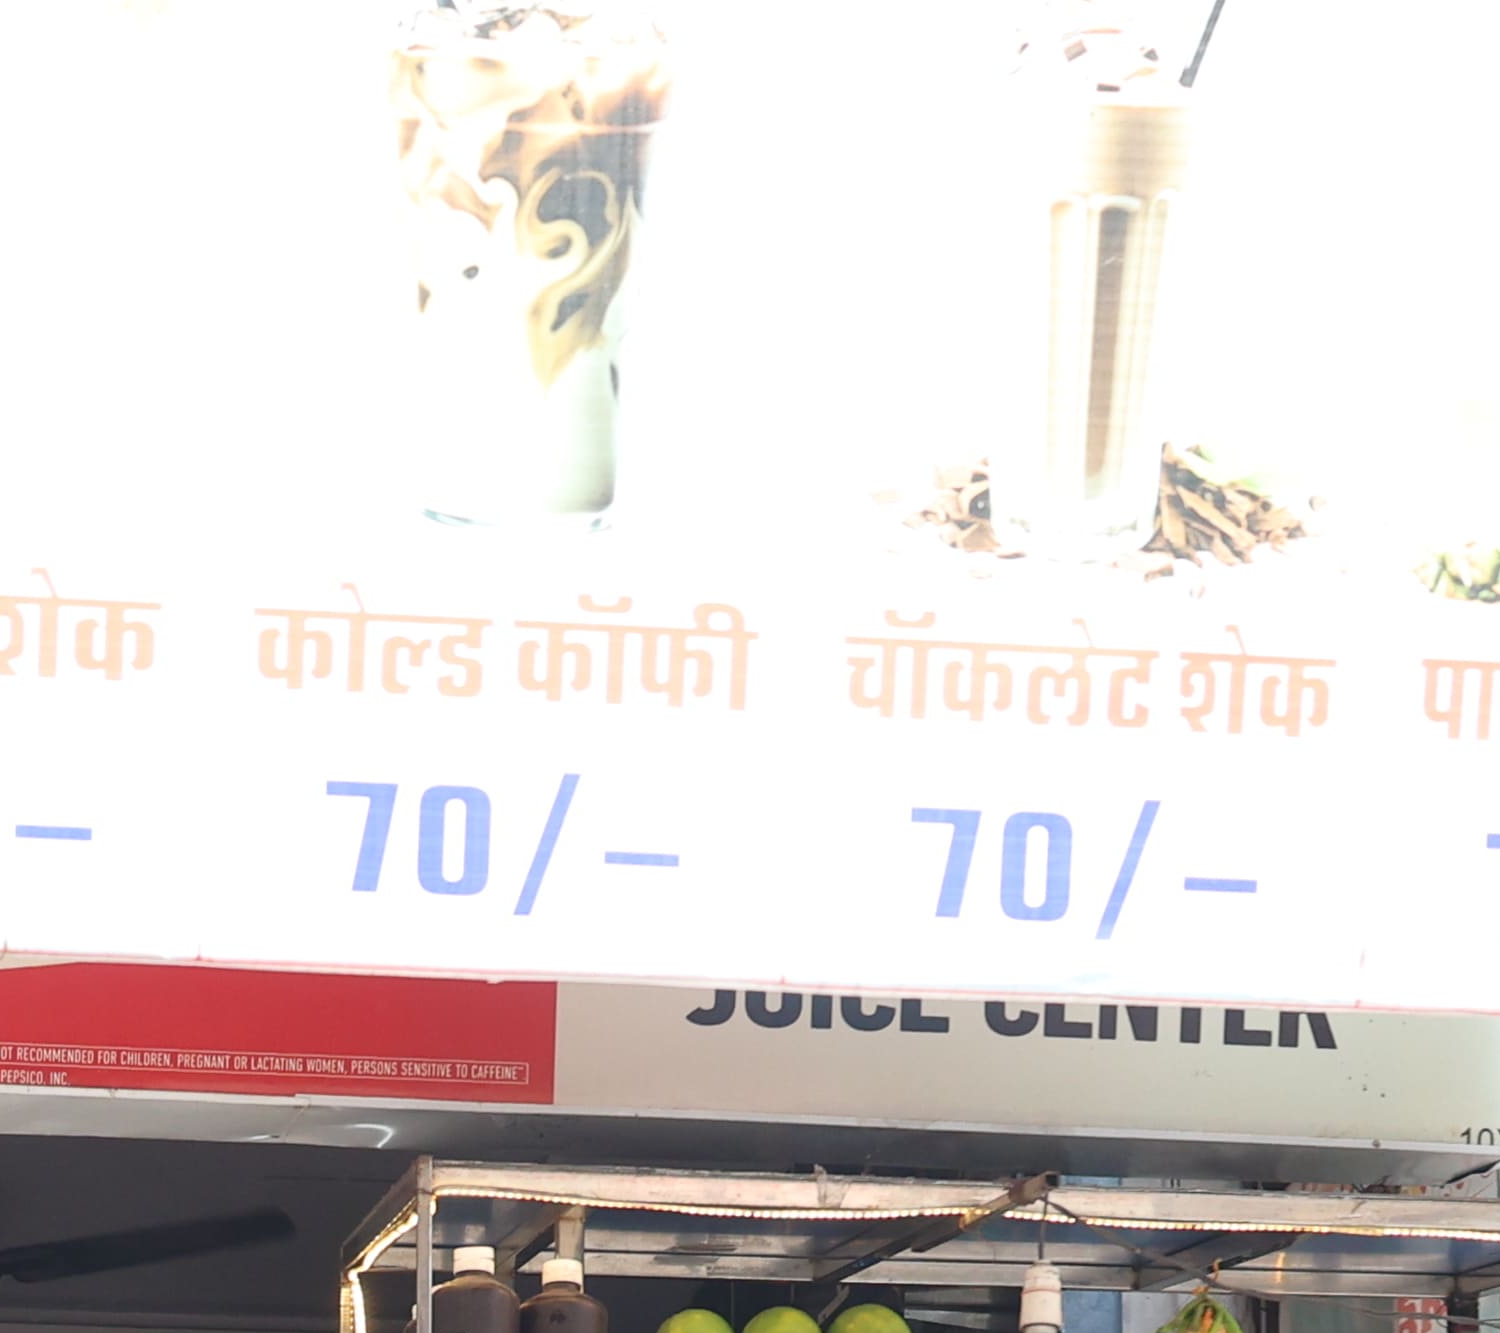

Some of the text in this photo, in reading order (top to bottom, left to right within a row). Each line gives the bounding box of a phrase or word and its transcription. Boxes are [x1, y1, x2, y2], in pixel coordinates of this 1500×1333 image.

[255, 581, 759, 711] कोल्ड कॉफी
[844, 609, 1337, 740] चॉकलेट शेक
